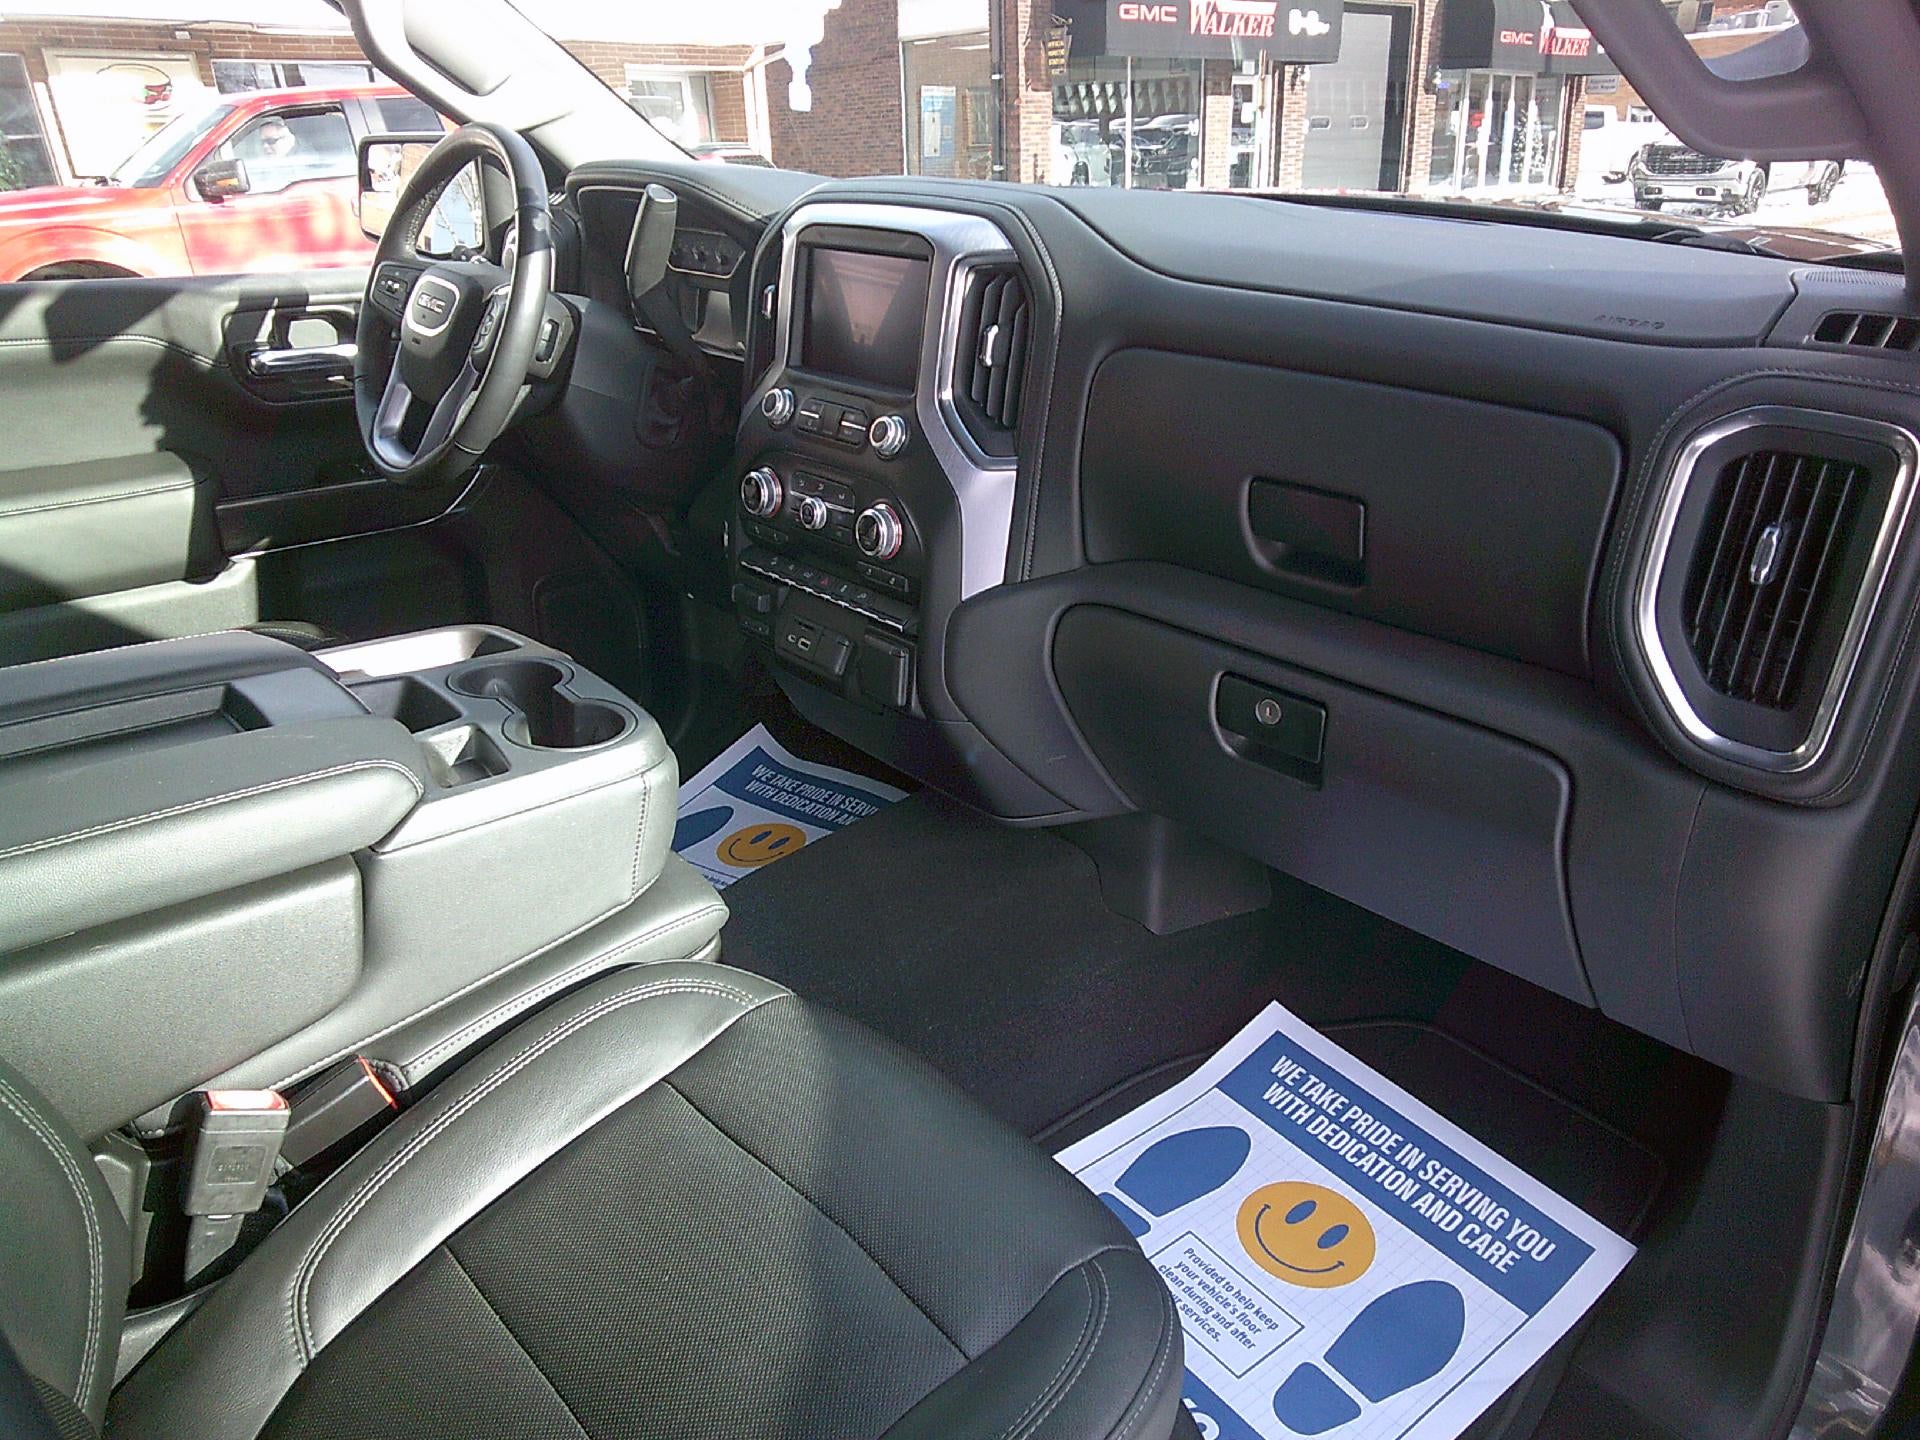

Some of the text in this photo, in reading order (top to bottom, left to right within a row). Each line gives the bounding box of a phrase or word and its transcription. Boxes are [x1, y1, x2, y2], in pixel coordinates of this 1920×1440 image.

[1119, 0, 1275, 37] GMC WALKER
[1500, 27, 1590, 56] GMC WALKER
[745, 779, 858, 826] WITH DEDICATION AN
[752, 764, 879, 816] WE TAKE PRIDE IN SERVI
[1262, 1082, 1521, 1273] WITH DEDICATION AND CARE
[1271, 1055, 1556, 1262] WE TAKE PRIDE IN SERVING YOU
[1158, 1264, 1256, 1349] clean during and after
[1174, 1261, 1262, 1334] your vehicle's floor
[1184, 1247, 1279, 1330] Provided to help keep
[1179, 1303, 1221, 1342] services.
